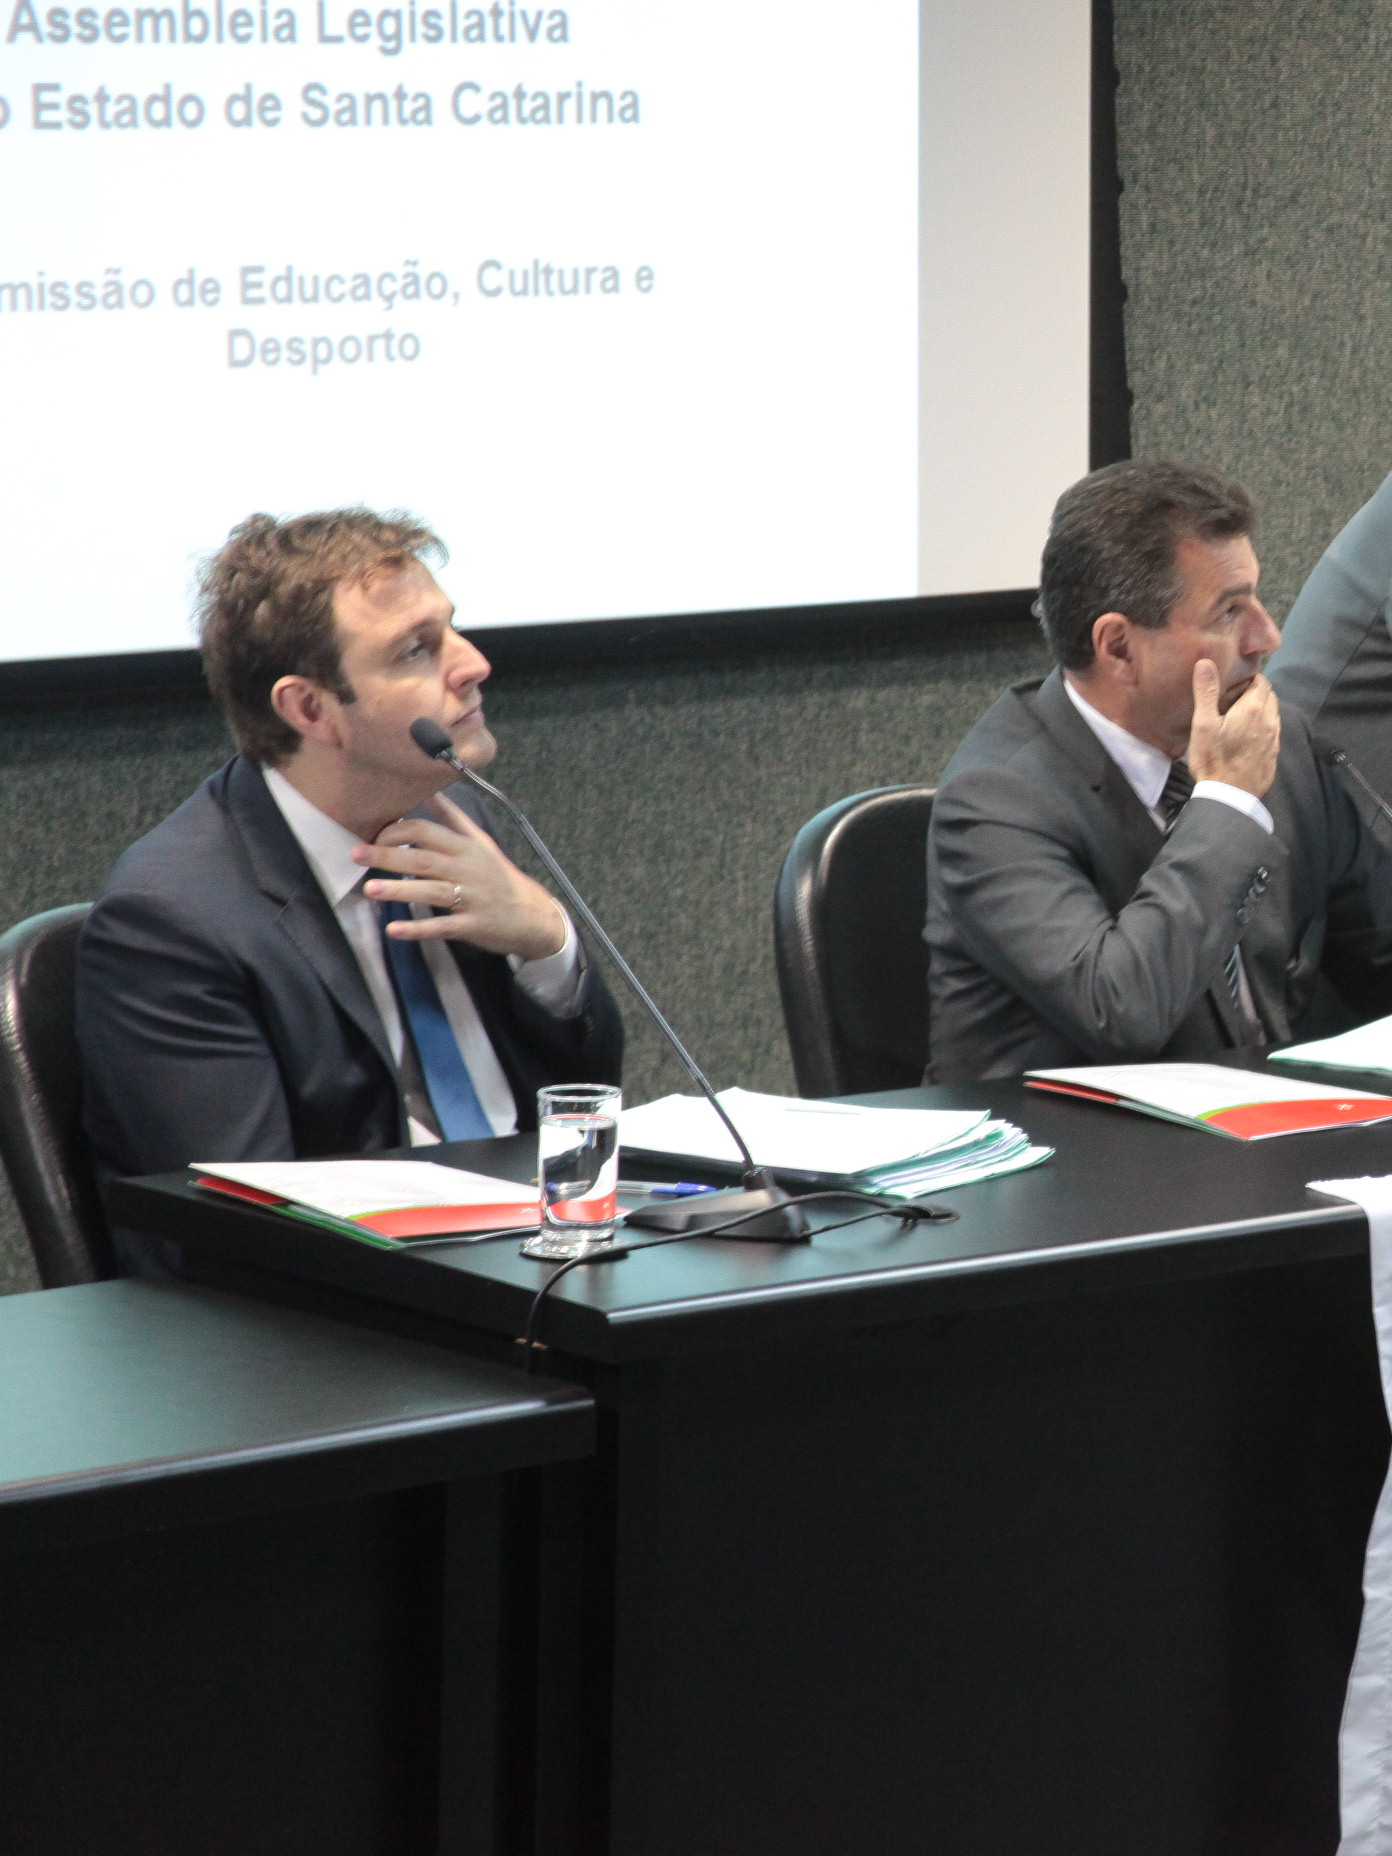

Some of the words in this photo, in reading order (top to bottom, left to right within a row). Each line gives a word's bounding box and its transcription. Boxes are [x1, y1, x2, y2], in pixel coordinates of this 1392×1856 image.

[6, 0, 298, 45] Assembleia
[317, 0, 570, 57] Legislativa
[32, 82, 206, 130] Estado
[224, 82, 283, 129] de
[301, 82, 434, 128] Santa
[451, 80, 640, 126] Catarina
[172, 267, 222, 308] de
[241, 259, 460, 312] Educação,
[477, 258, 620, 298] Cultura
[635, 265, 655, 294] e
[227, 328, 421, 376] Desporto
